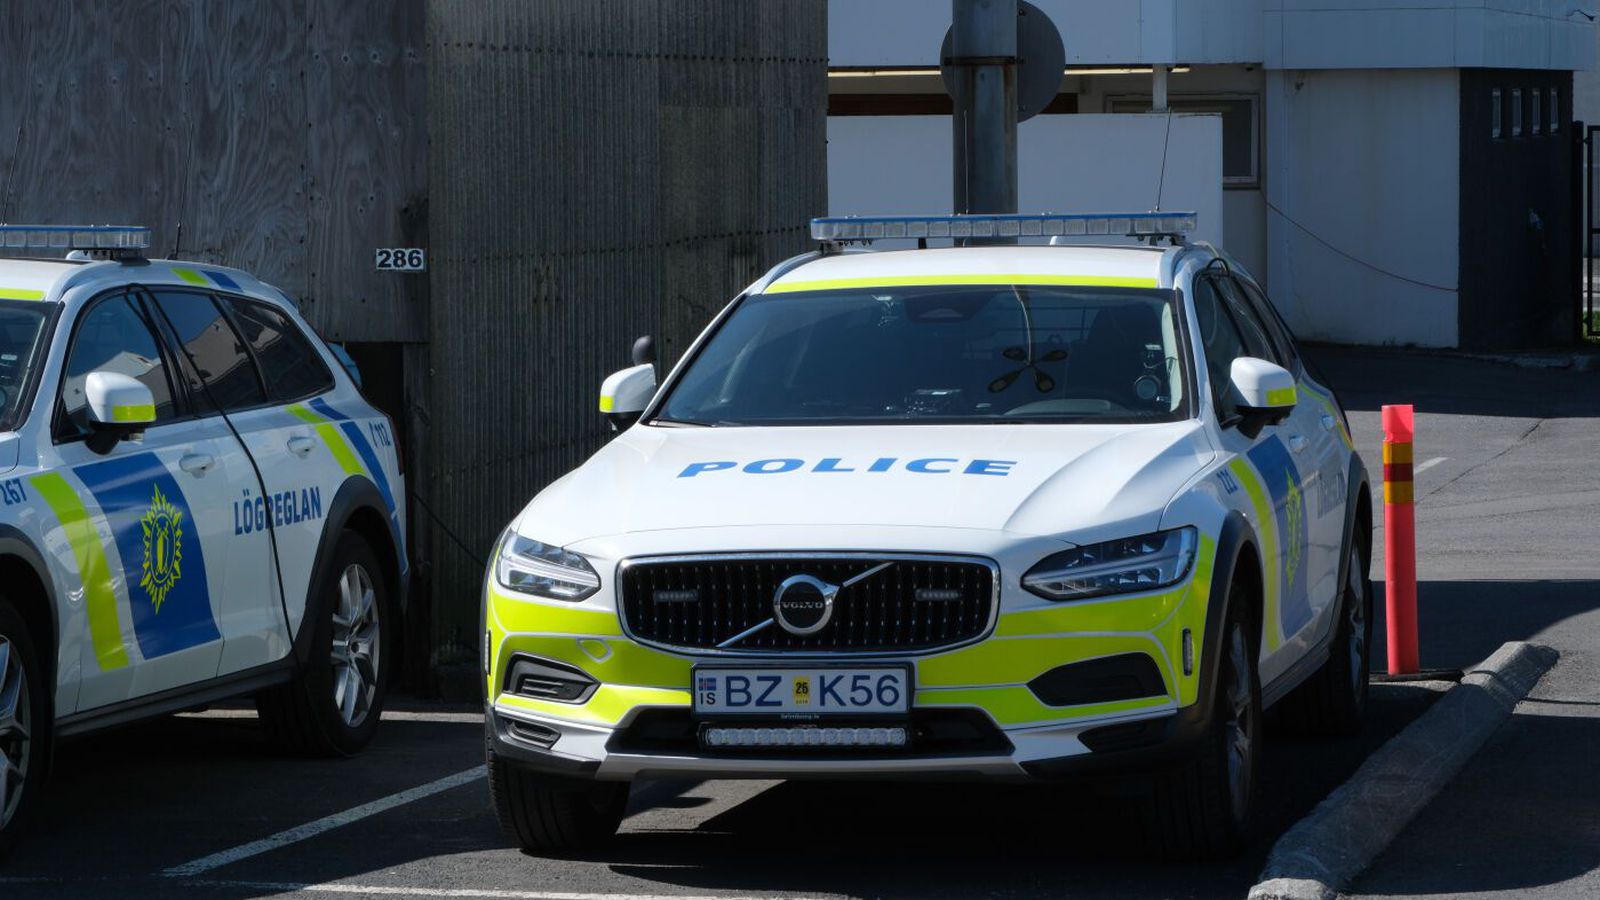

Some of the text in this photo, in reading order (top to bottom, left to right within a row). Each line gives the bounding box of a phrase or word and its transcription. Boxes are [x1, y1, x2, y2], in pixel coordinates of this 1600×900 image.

[377, 249, 423, 268] 286
[676, 457, 1018, 478] POLICE
[782, 601, 824, 609] VOLVO
[725, 674, 900, 707] BZ K56
[795, 682, 809, 695] 26
[700, 692, 716, 705] IS
